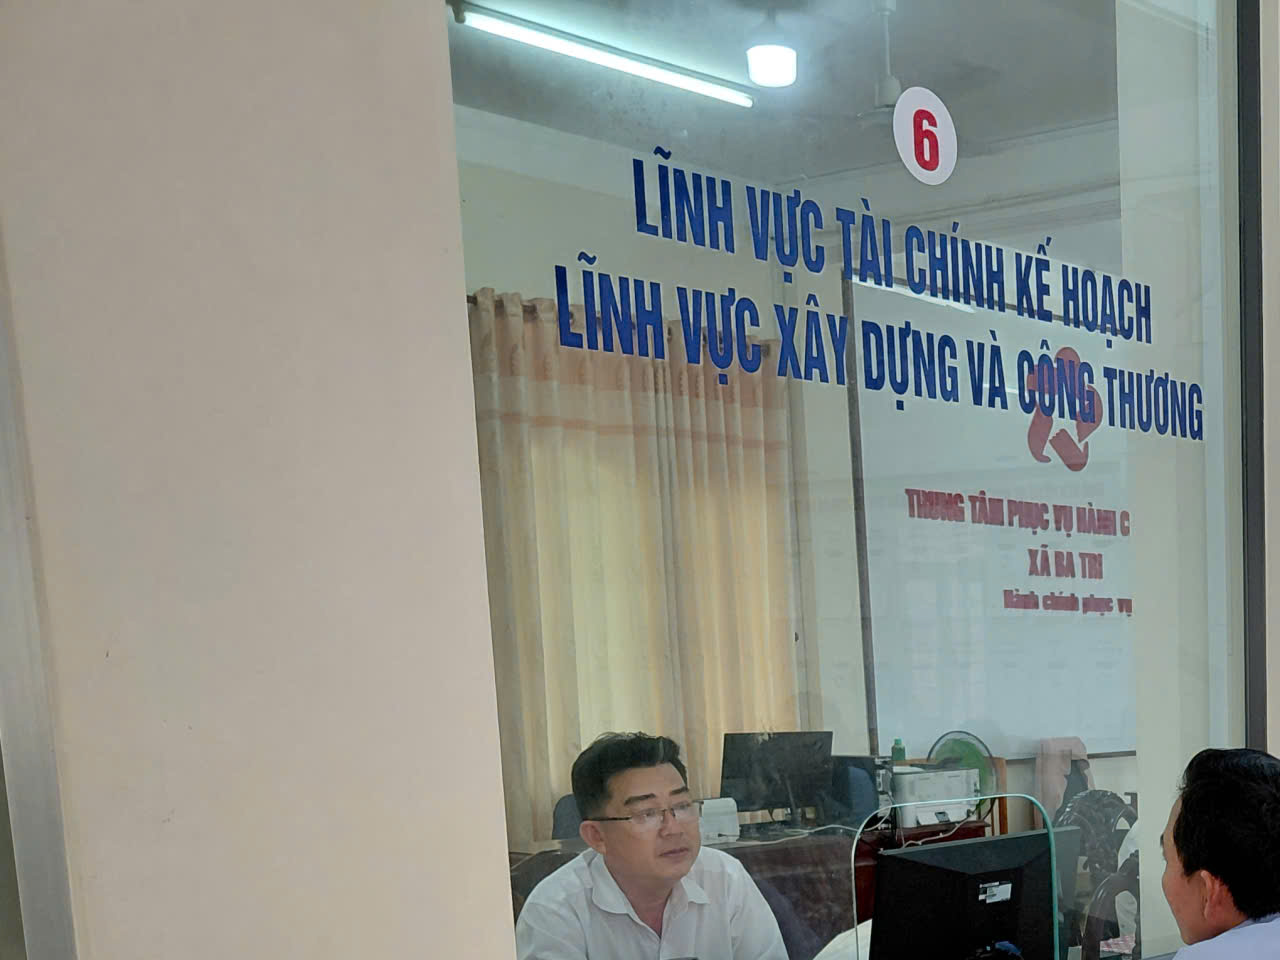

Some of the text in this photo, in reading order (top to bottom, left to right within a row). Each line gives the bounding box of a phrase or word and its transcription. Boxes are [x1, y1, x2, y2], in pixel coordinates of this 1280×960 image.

[913, 109, 940, 172] 6
[632, 146, 1152, 349] LĨNH VỰC TÀI CHÍNH KẾ HOẠCH
[554, 251, 1205, 441] LĨNH VỰC XÂY DỰNG VÀ CÔNG THƯƠNG
